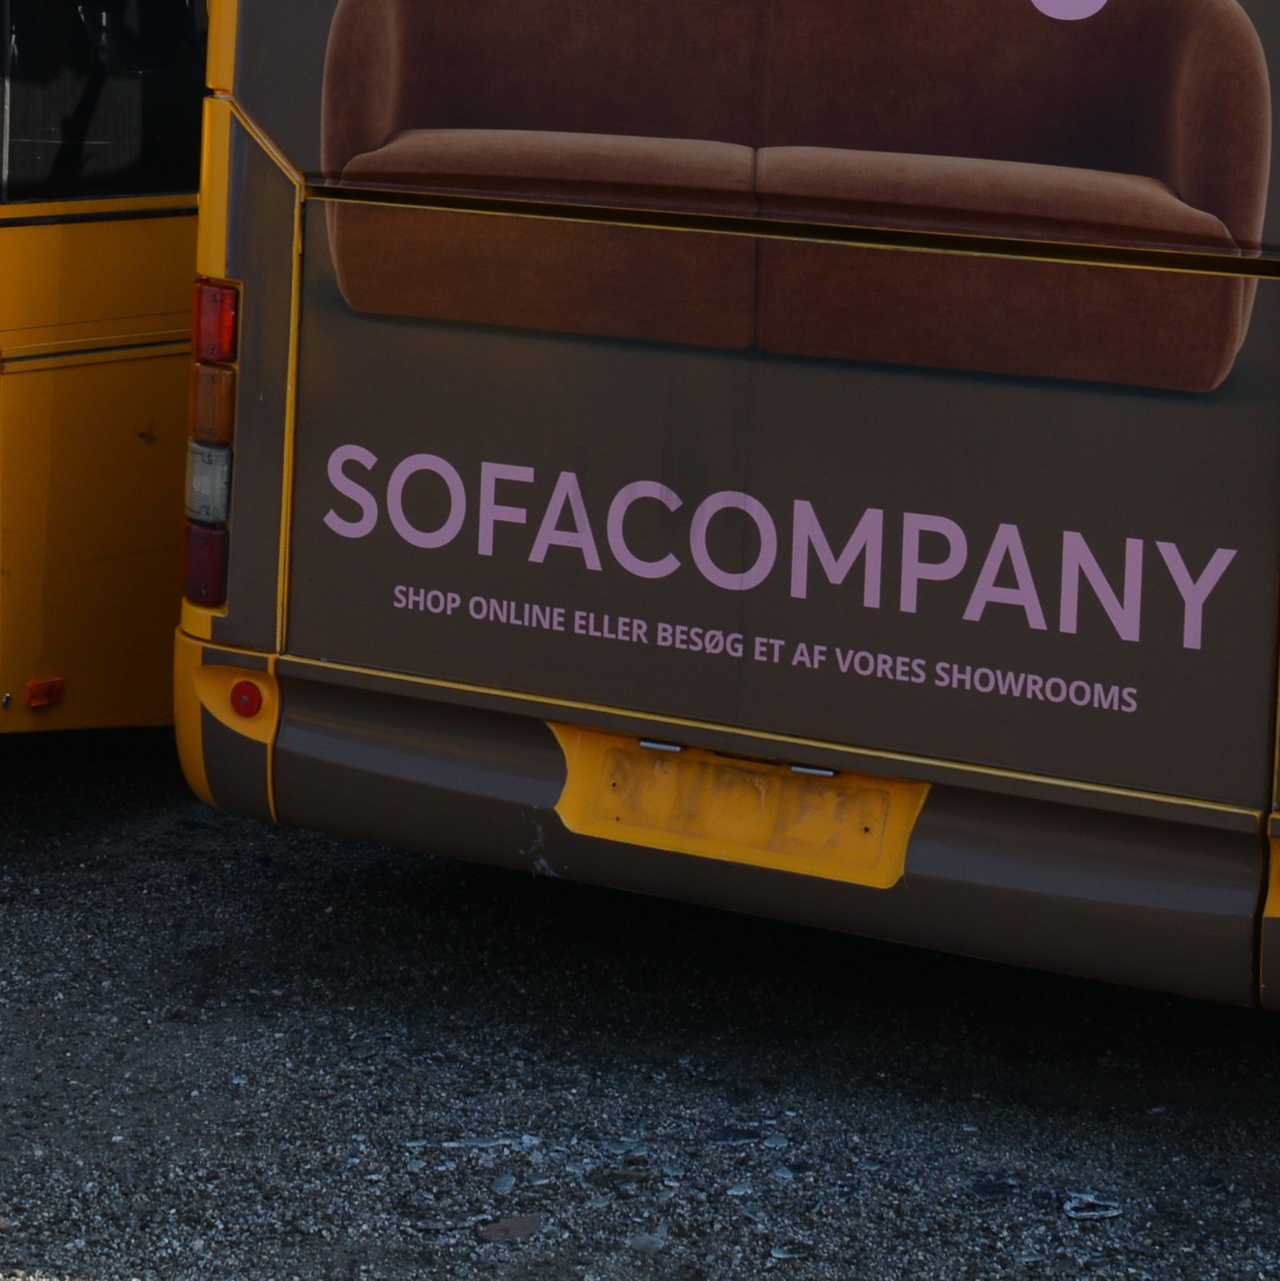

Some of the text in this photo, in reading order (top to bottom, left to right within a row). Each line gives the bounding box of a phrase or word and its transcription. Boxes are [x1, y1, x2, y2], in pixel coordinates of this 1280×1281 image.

[323, 444, 1238, 650] SOFACOMPANY
[393, 584, 1138, 713] SHOP ONLINE ELLER BESØG ET AF VORES SHOWROOMS
